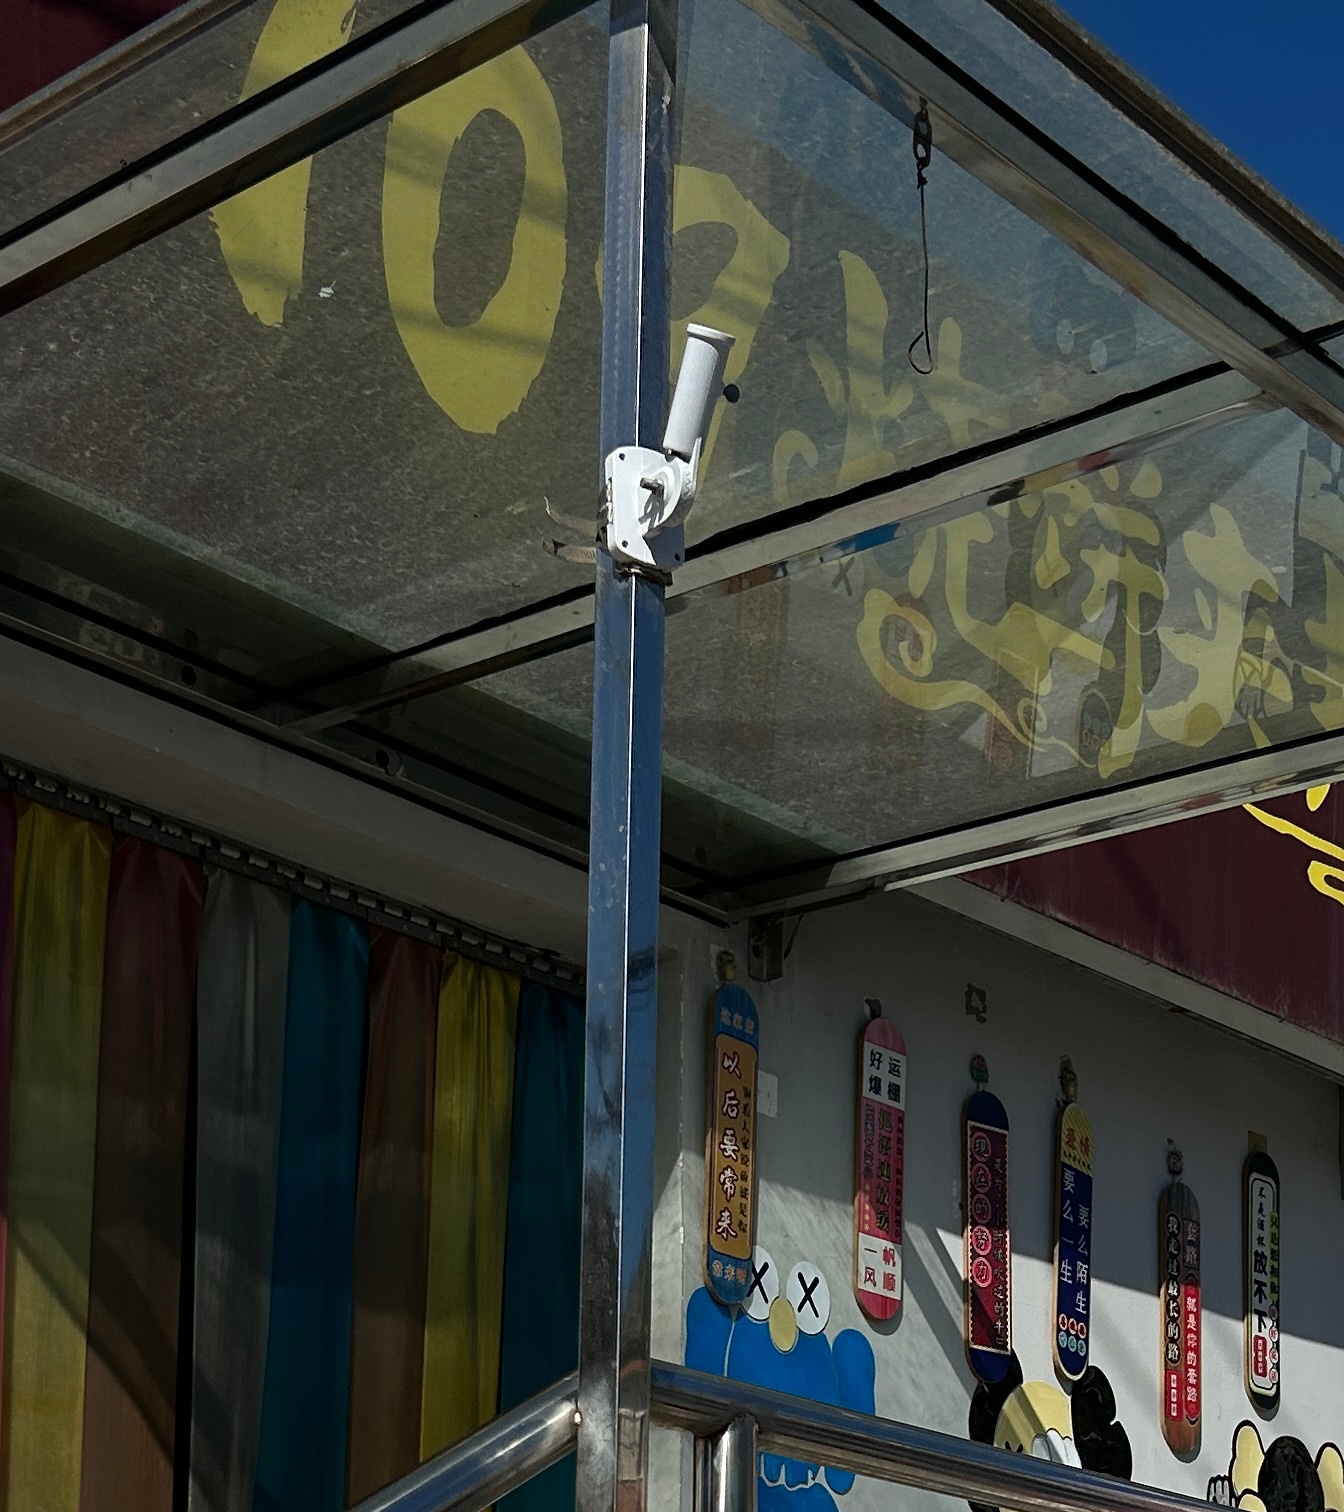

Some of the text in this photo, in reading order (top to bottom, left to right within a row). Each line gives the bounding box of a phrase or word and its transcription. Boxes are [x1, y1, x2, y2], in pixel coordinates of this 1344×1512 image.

[716, 1052, 742, 1242] 以后要常来
[1061, 1167, 1076, 1285] 要么一生
[1076, 1204, 1090, 1315] 要么陌生
